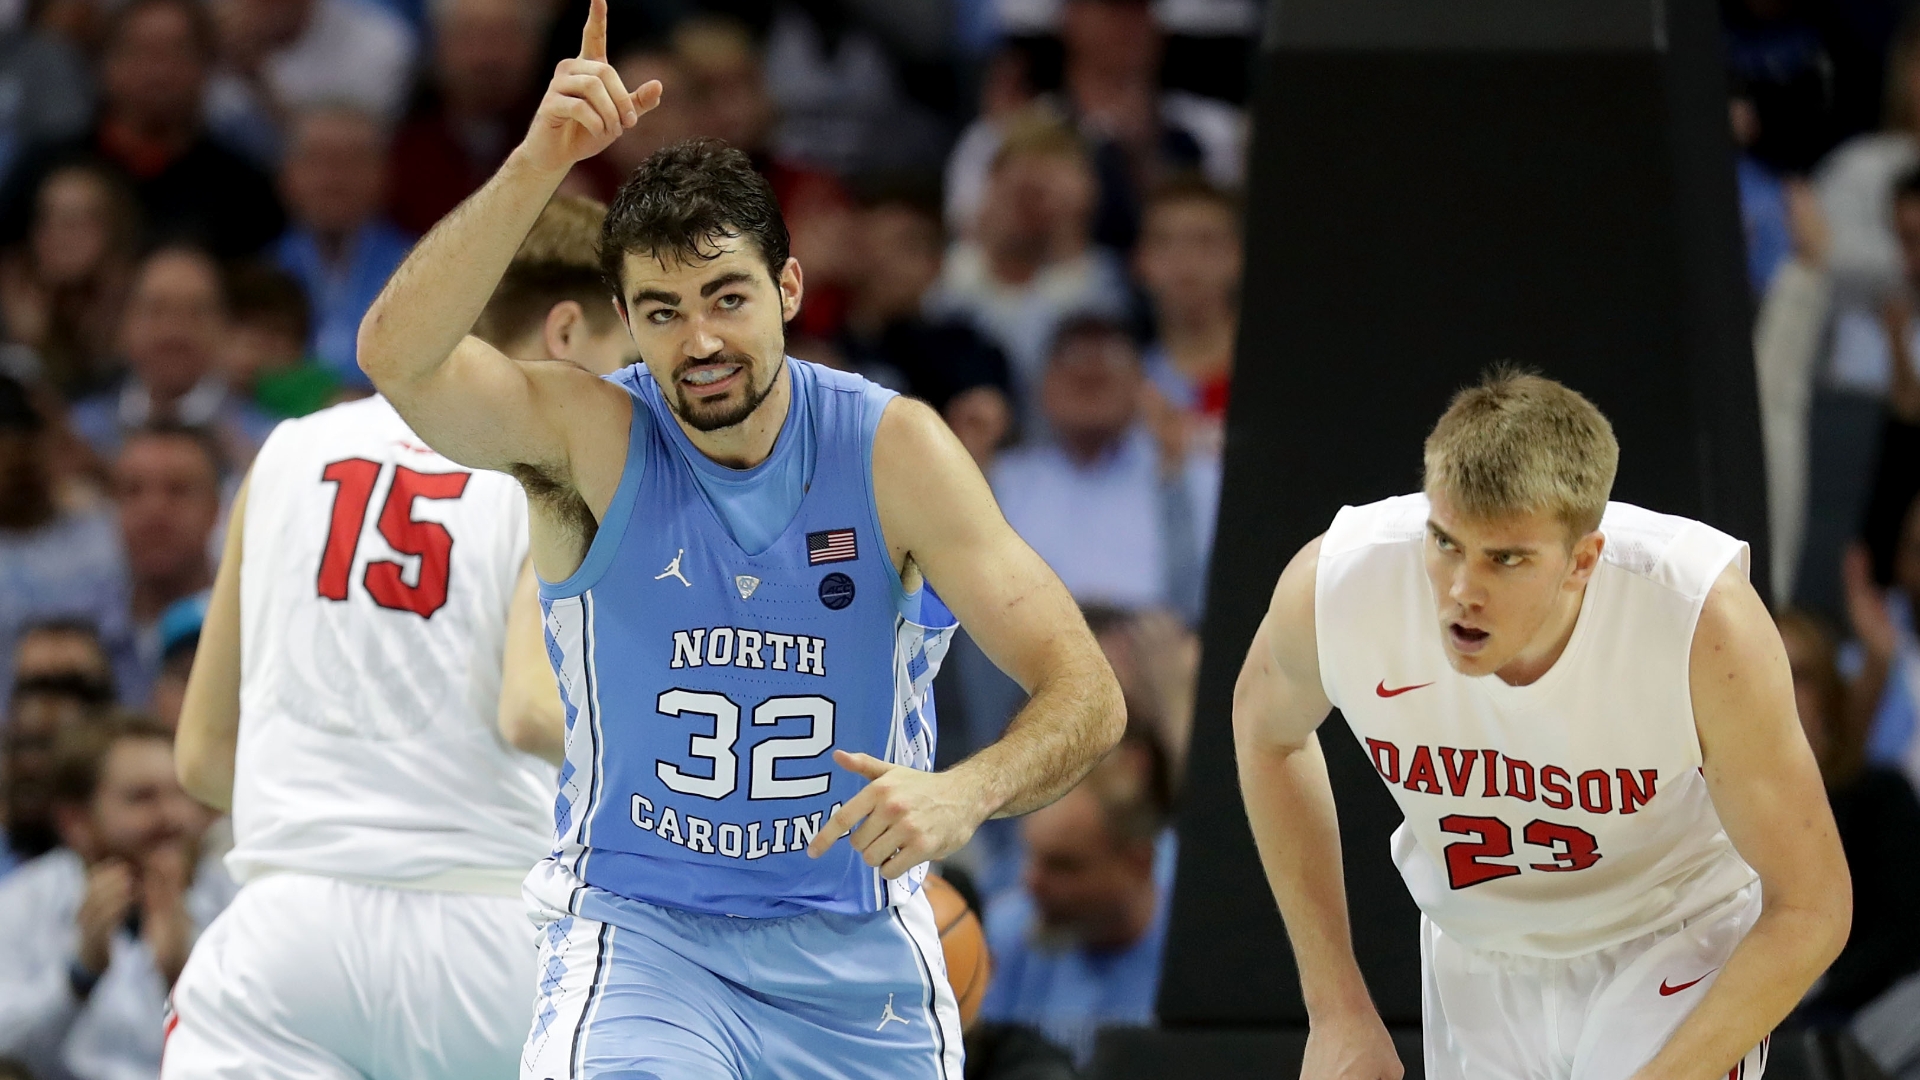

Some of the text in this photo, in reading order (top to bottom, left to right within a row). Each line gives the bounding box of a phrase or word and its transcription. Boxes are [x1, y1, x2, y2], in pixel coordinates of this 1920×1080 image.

[317, 457, 472, 619] 15
[670, 626, 826, 677] NORTH
[655, 687, 837, 801] 32
[1365, 736, 1659, 815] DAVIDSON
[1439, 814, 1603, 890] 23
